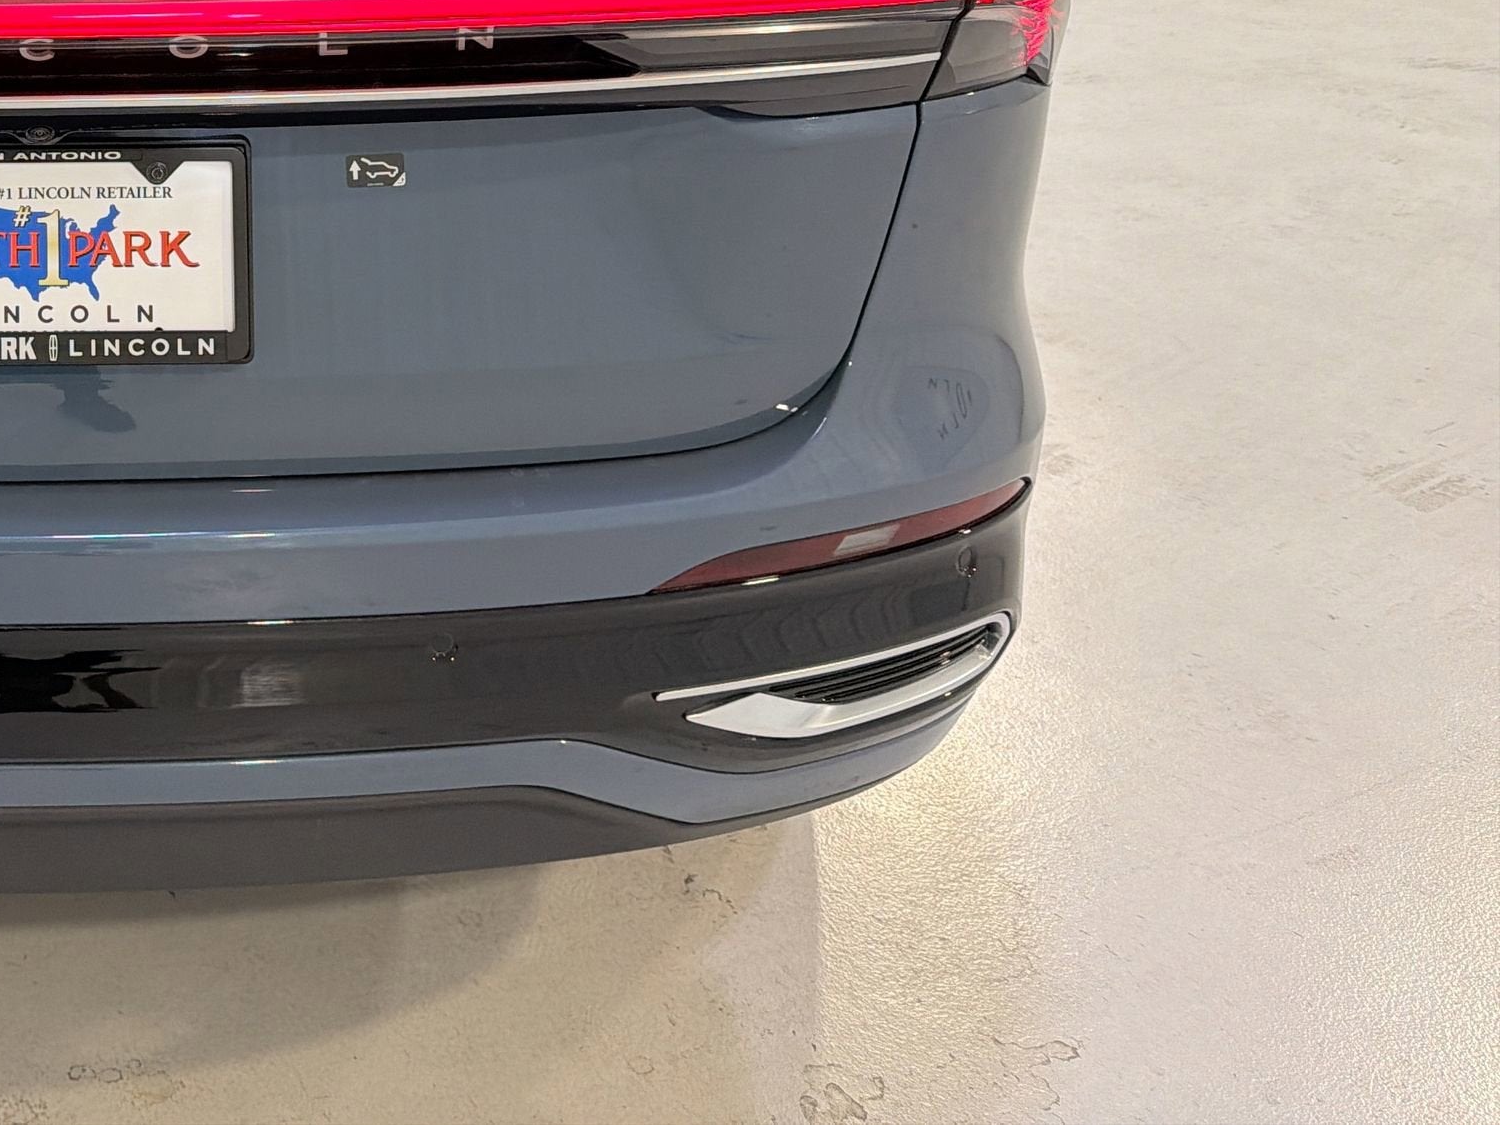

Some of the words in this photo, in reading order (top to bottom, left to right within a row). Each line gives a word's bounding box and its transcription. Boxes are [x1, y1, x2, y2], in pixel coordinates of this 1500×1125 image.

[13, 151, 122, 161] ANTONIO
[18, 186, 91, 200] LINCOLN
[96, 186, 173, 199] RETAILER
[68, 230, 200, 268] PARK
[69, 337, 215, 357] LINCOLN
